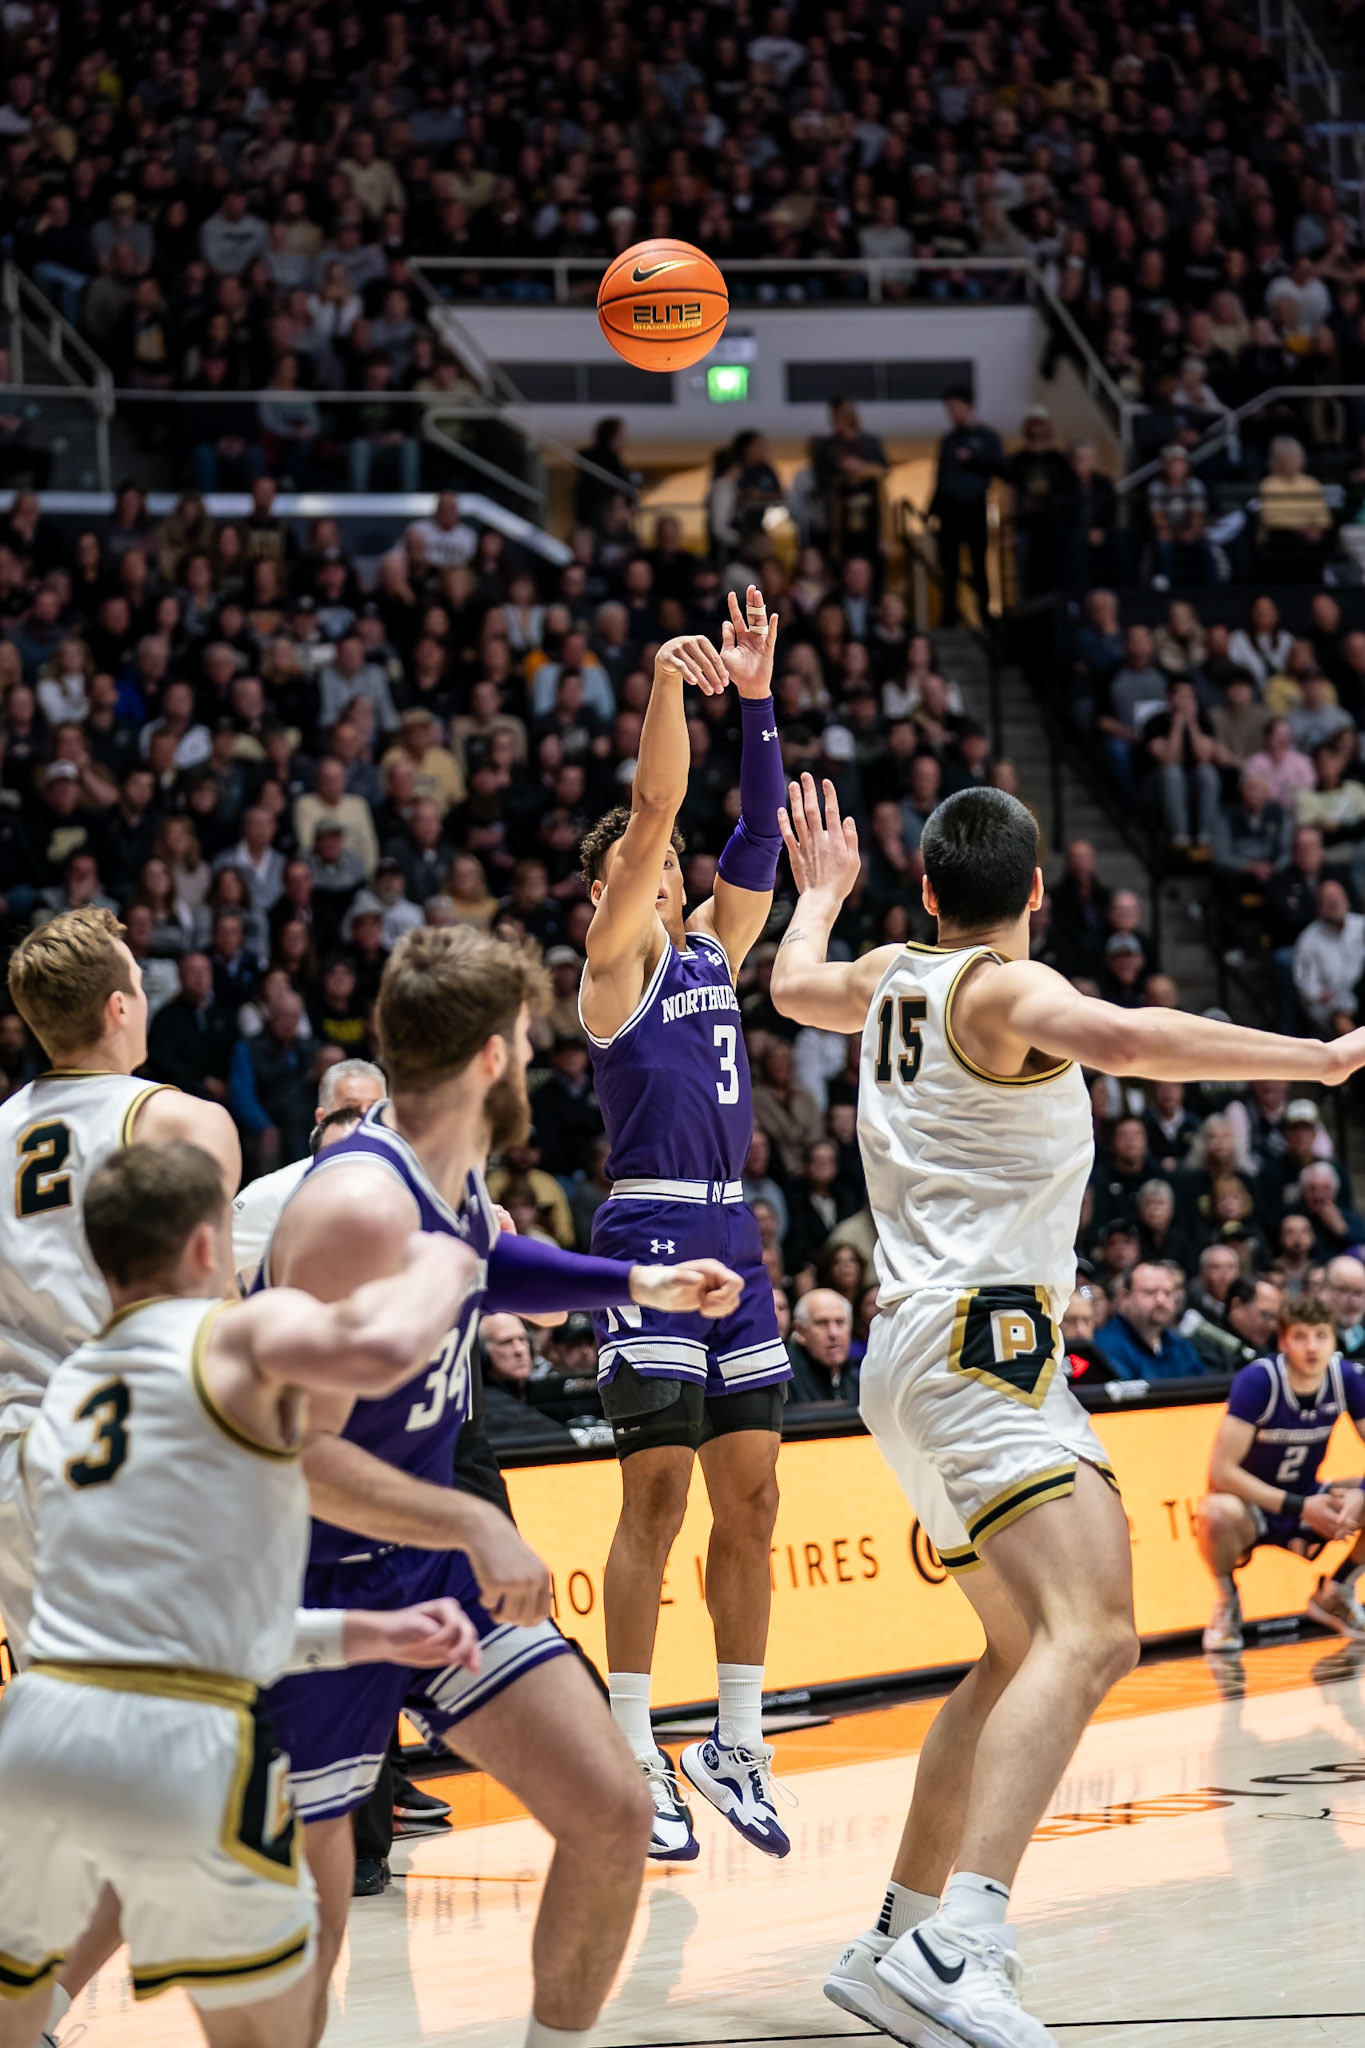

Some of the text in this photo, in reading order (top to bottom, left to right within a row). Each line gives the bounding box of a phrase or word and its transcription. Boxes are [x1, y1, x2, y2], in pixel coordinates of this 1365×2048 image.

[632, 303, 701, 323] ELITE
[713, 1024, 740, 1105] 3
[874, 995, 927, 1085] 15
[15, 1118, 72, 1219] 2
[404, 1307, 480, 1433] 34
[990, 1309, 1038, 1363] P
[63, 1373, 133, 1491] 3
[1274, 1445, 1310, 1484] 2
